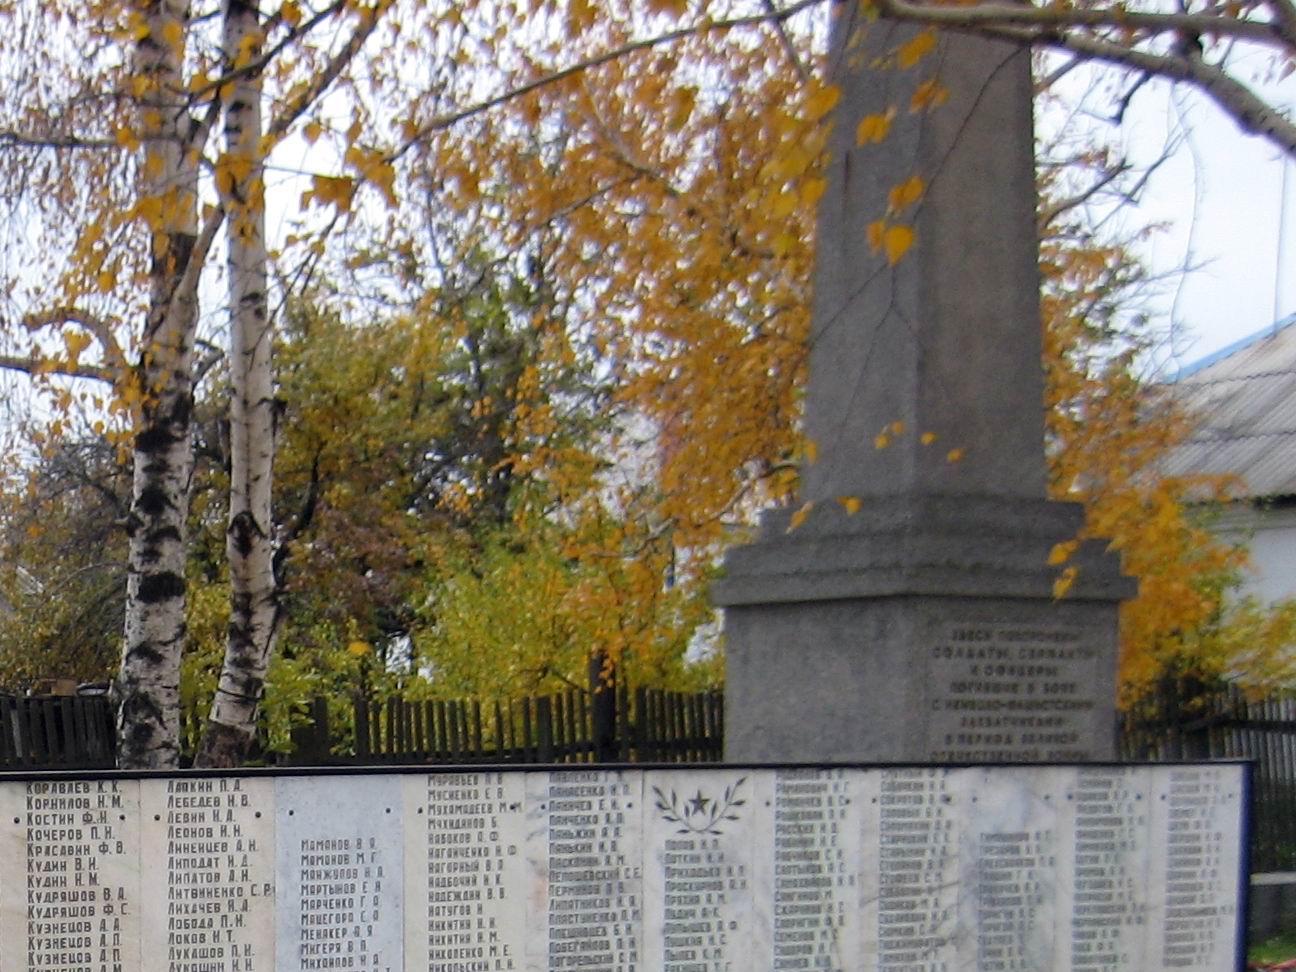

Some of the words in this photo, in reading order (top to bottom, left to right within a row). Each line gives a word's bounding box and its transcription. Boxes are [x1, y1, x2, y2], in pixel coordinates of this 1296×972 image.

[168, 795, 220, 808] ЛЕБЕДЕВ
[28, 890, 96, 903] КУДРЯШОВ
[168, 932, 205, 945] ЛОКОВ
